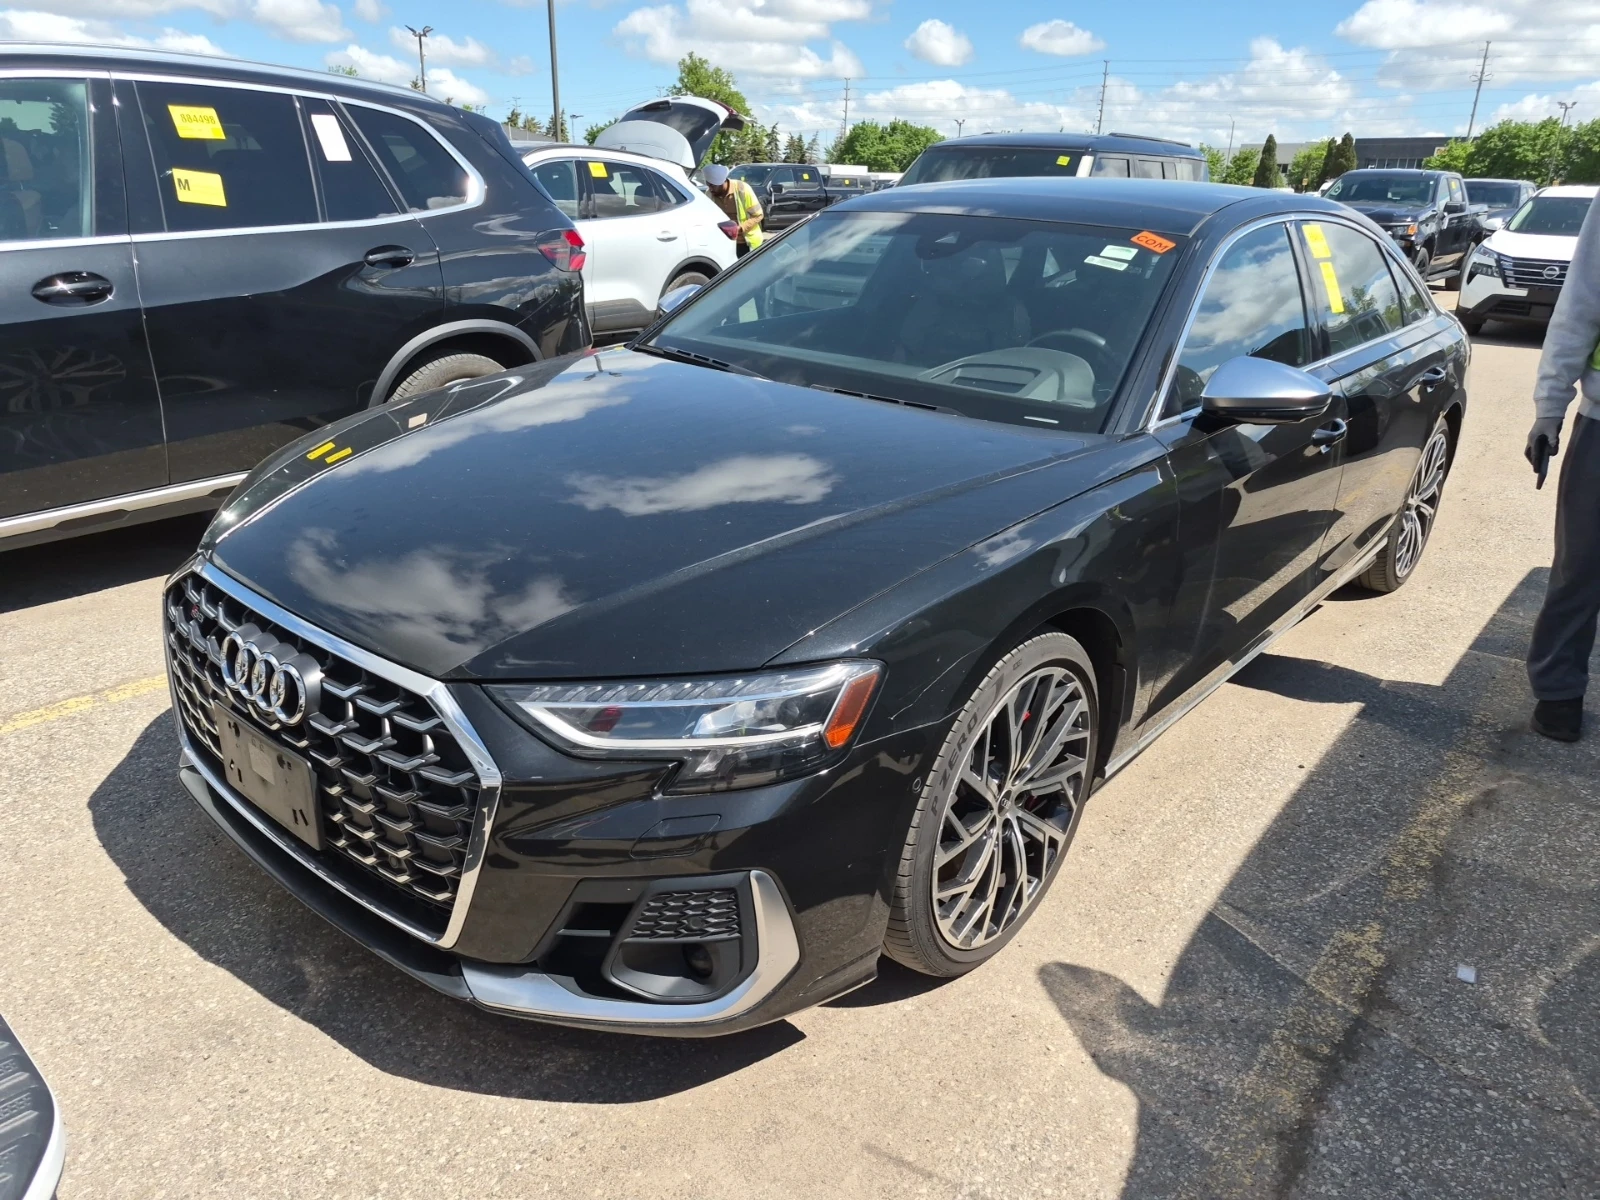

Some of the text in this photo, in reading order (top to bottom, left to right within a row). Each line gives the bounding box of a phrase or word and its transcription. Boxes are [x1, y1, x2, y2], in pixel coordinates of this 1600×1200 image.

[180, 113, 216, 125] 884498
[177, 178, 191, 191] M
[1137, 235, 1167, 252] COM
[930, 711, 978, 817] P ZERO
